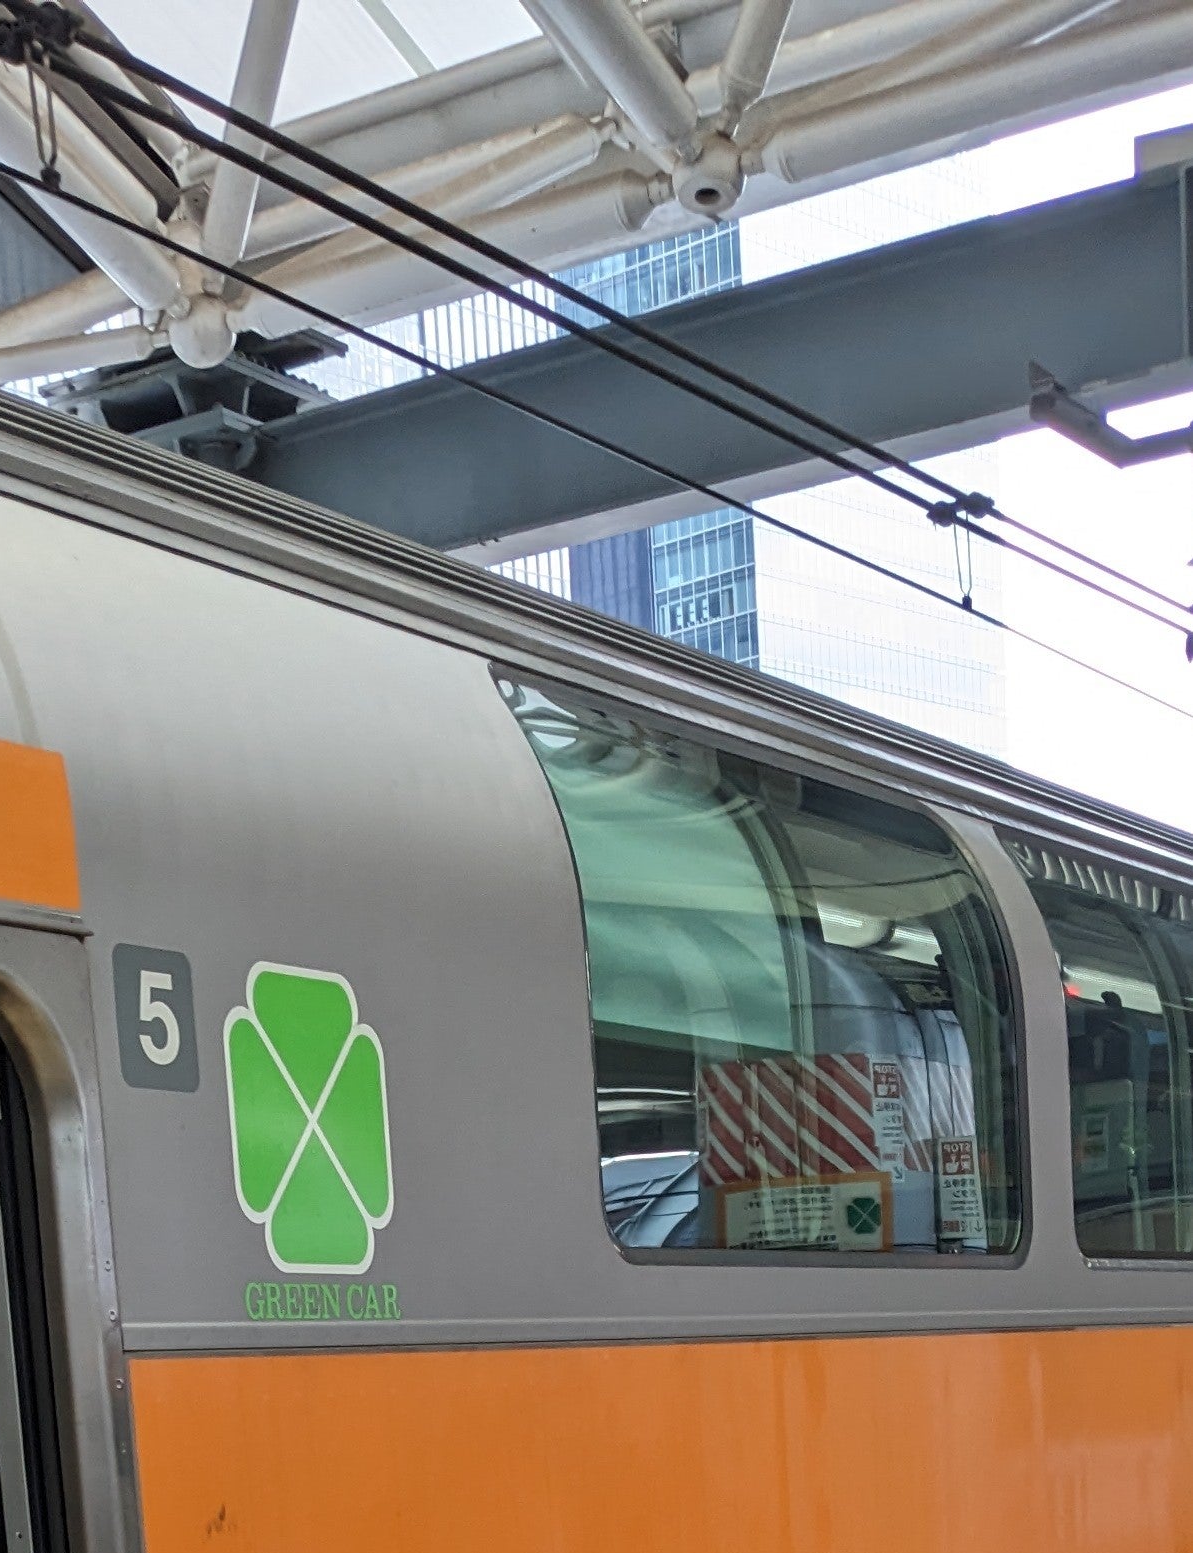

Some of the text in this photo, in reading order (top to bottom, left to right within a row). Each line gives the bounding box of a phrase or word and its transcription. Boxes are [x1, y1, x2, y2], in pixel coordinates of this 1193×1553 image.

[139, 969, 180, 1066] 5
[244, 1282, 401, 1321] GREEN CAR
